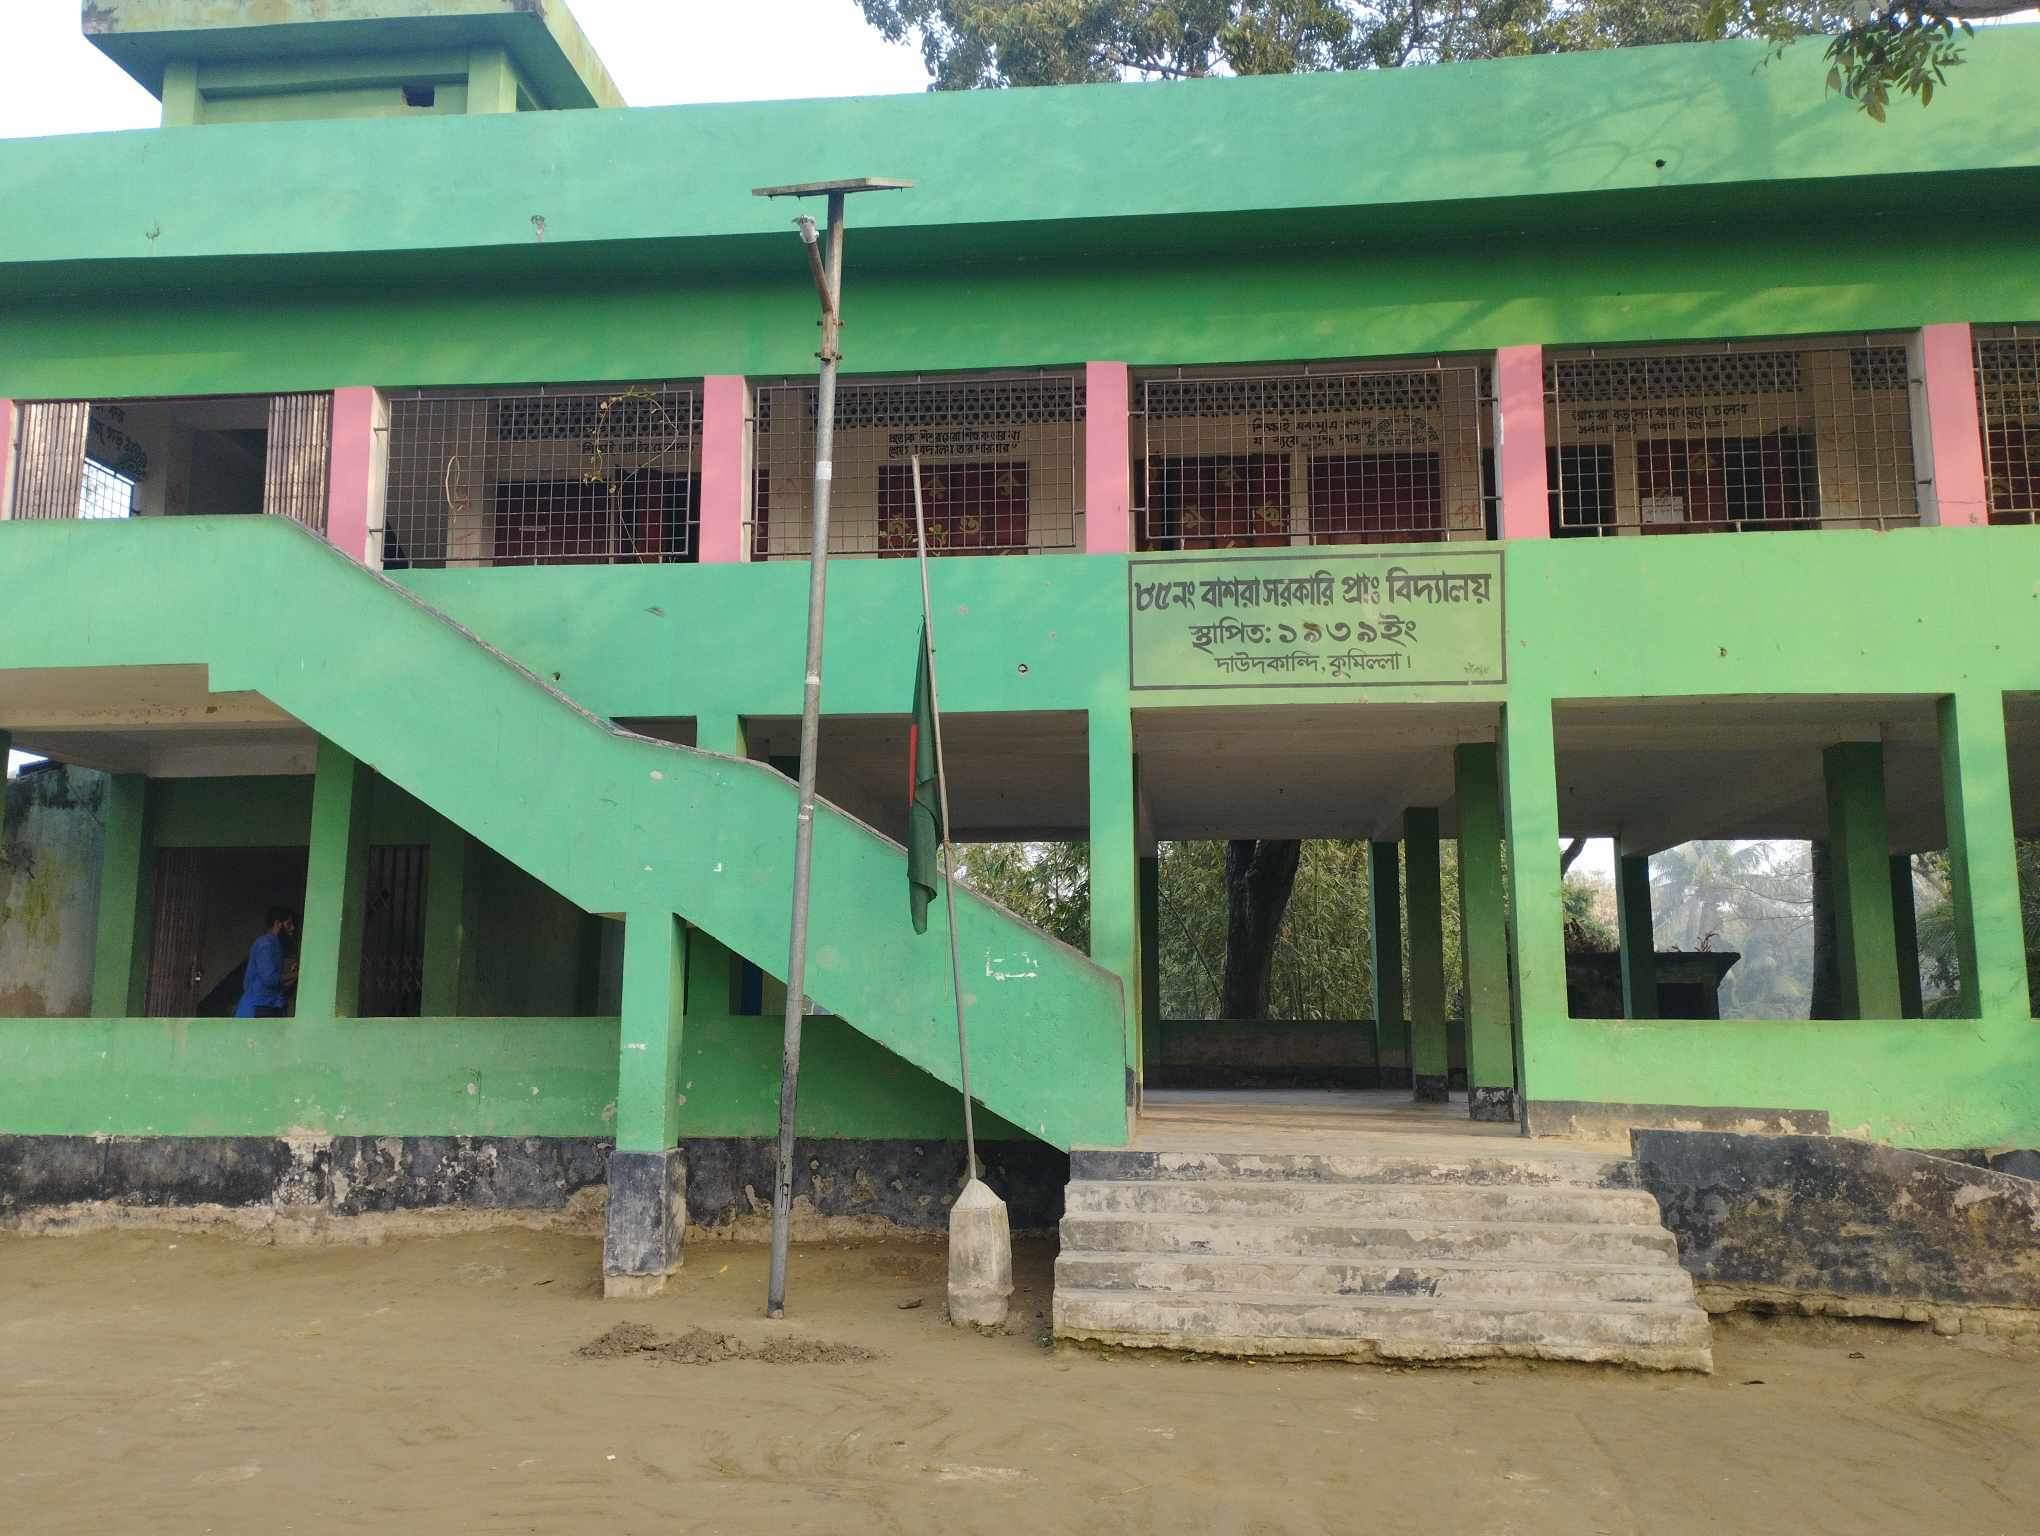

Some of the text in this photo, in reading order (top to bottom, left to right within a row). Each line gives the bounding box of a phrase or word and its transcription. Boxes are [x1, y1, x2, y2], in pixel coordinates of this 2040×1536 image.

[1200, 576, 1261, 608] বাশরা
[1262, 569, 1335, 607] সরকারি
[1386, 566, 1492, 605] বিদ্যালয়
